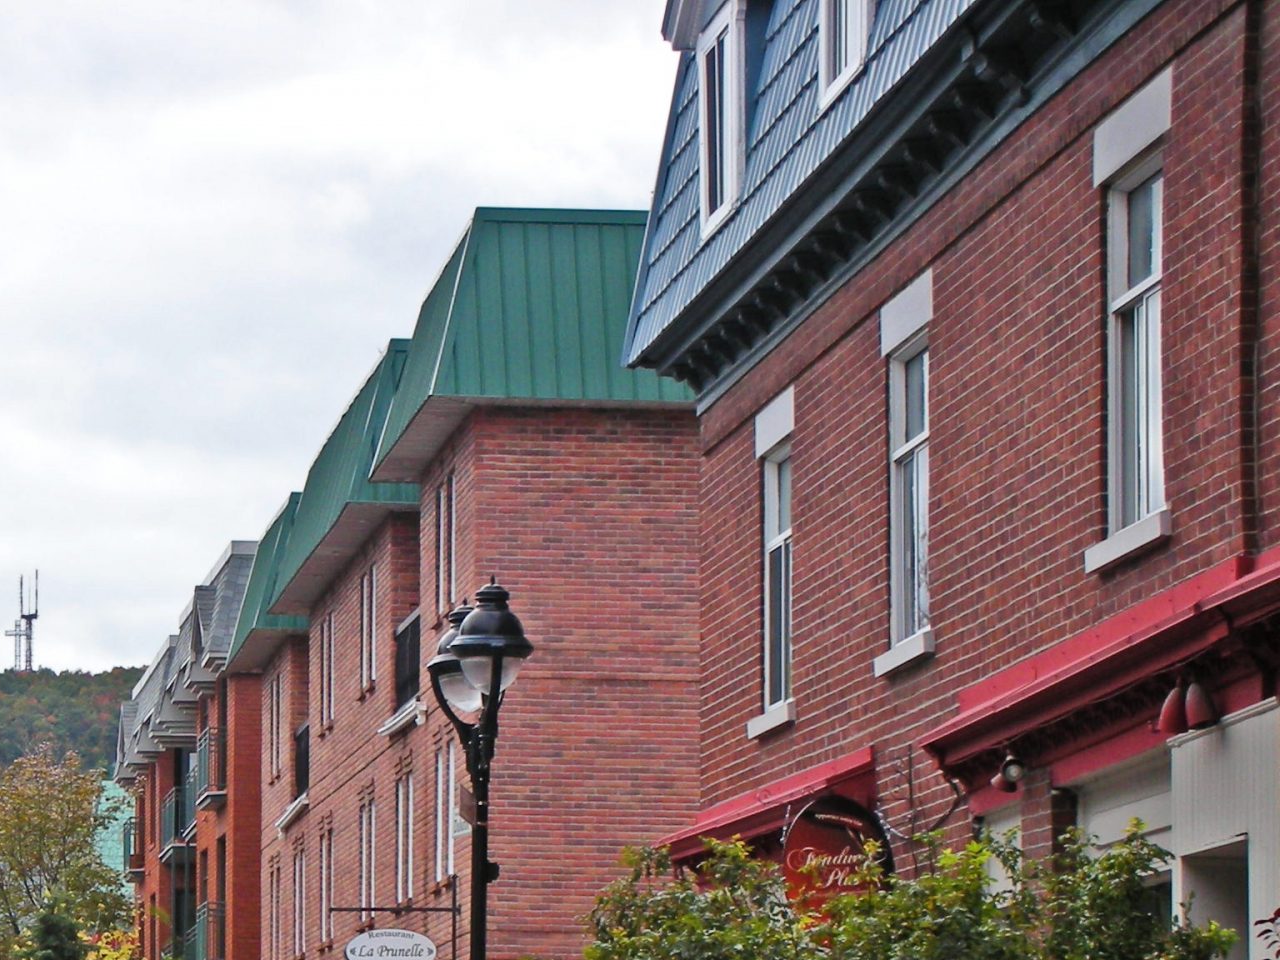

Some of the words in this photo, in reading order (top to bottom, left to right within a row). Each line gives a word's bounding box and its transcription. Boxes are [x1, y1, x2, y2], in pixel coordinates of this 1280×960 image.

[368, 931, 414, 940] Restaurant
[358, 945, 374, 957] La
[377, 944, 424, 957] Prunelle
